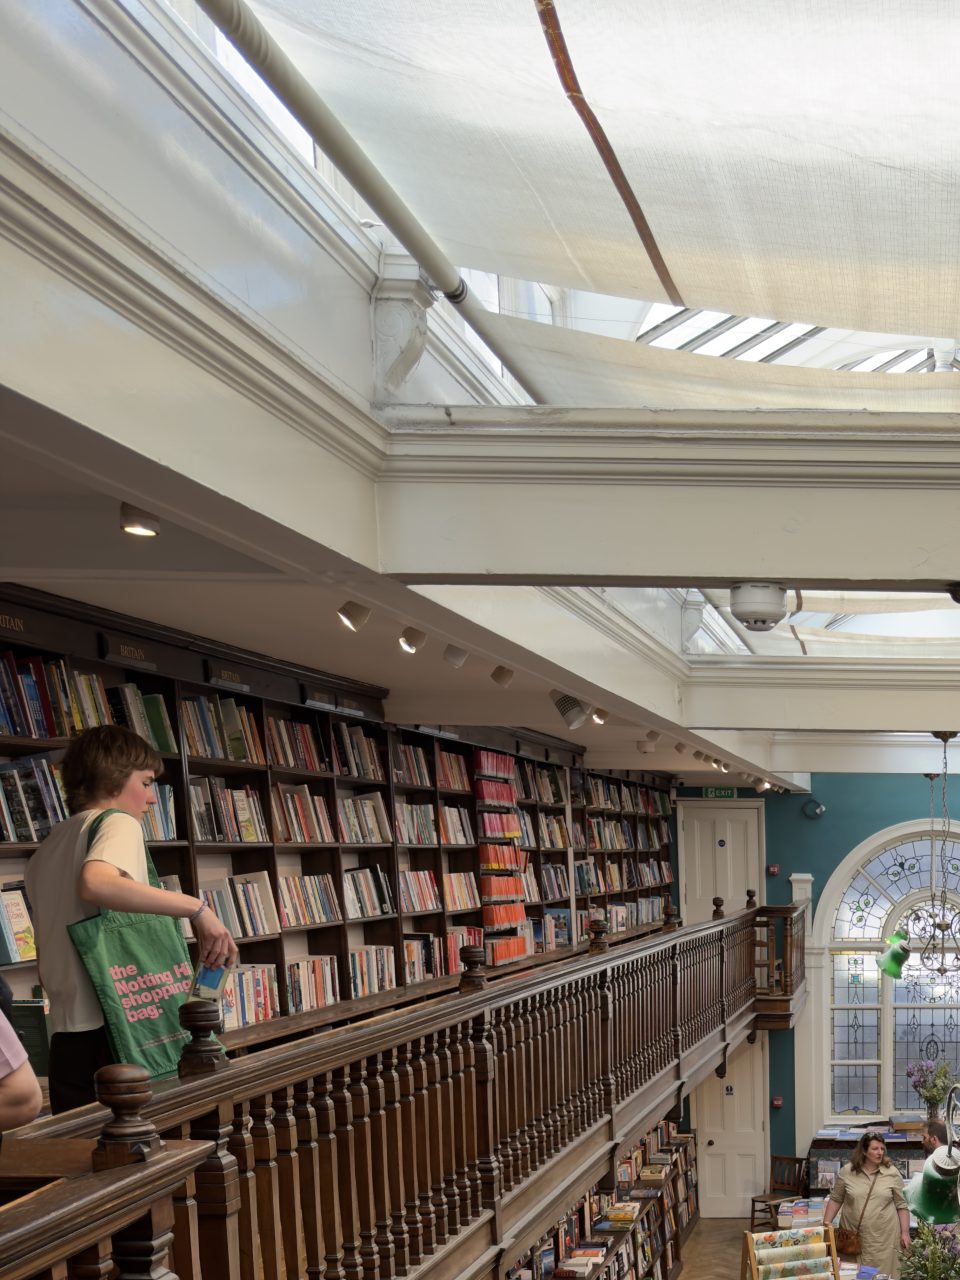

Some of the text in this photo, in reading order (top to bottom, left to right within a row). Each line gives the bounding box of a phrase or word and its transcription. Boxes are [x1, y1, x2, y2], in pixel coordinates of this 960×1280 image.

[120, 644, 145, 660] BRITAIN
[715, 788, 732, 797] EXIT
[108, 964, 138, 980] the
[113, 961, 193, 995] Notting Hi
[121, 979, 192, 1009] shopping
